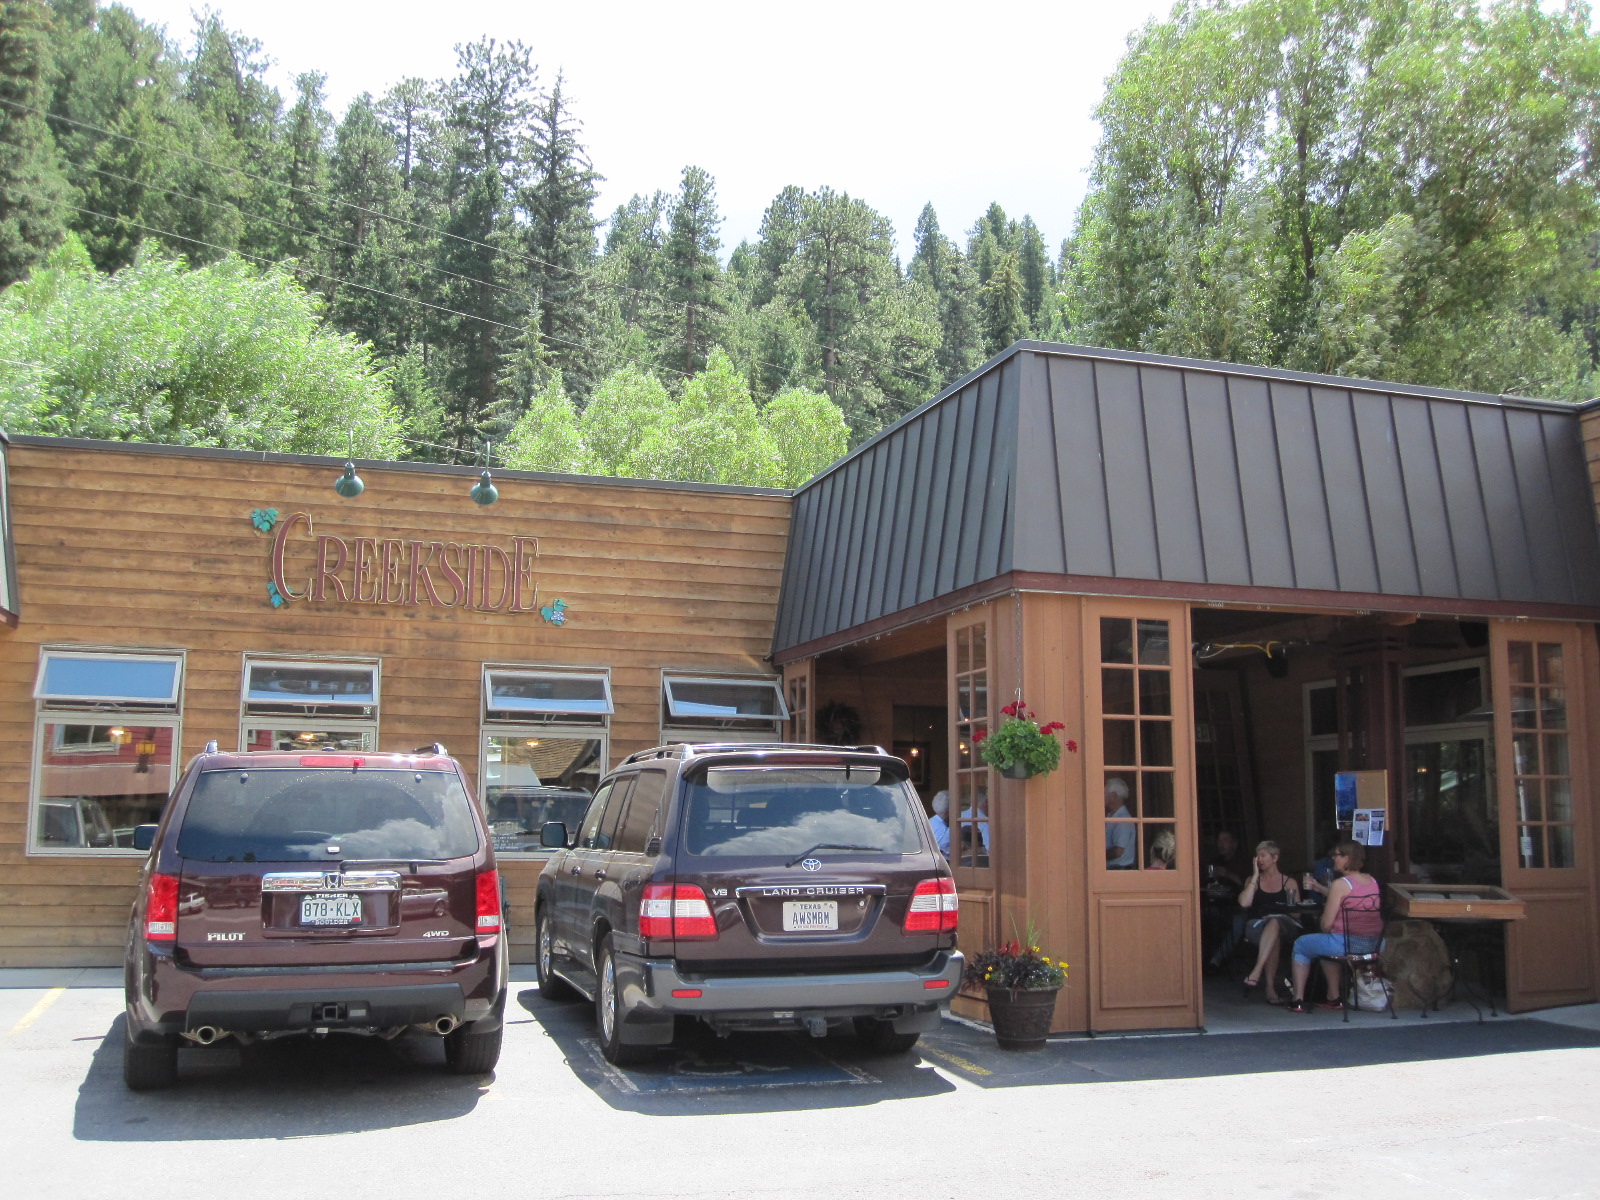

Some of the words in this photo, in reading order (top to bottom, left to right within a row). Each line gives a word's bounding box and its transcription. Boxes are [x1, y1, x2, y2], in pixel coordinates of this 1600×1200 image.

[272, 511, 540, 613] CREEKSIDE
[763, 888, 800, 896] LAND
[806, 887, 864, 895] CRUISER
[793, 911, 830, 925] AWSMBM
[207, 932, 246, 941] PILOT
[422, 930, 450, 938] 4WD
